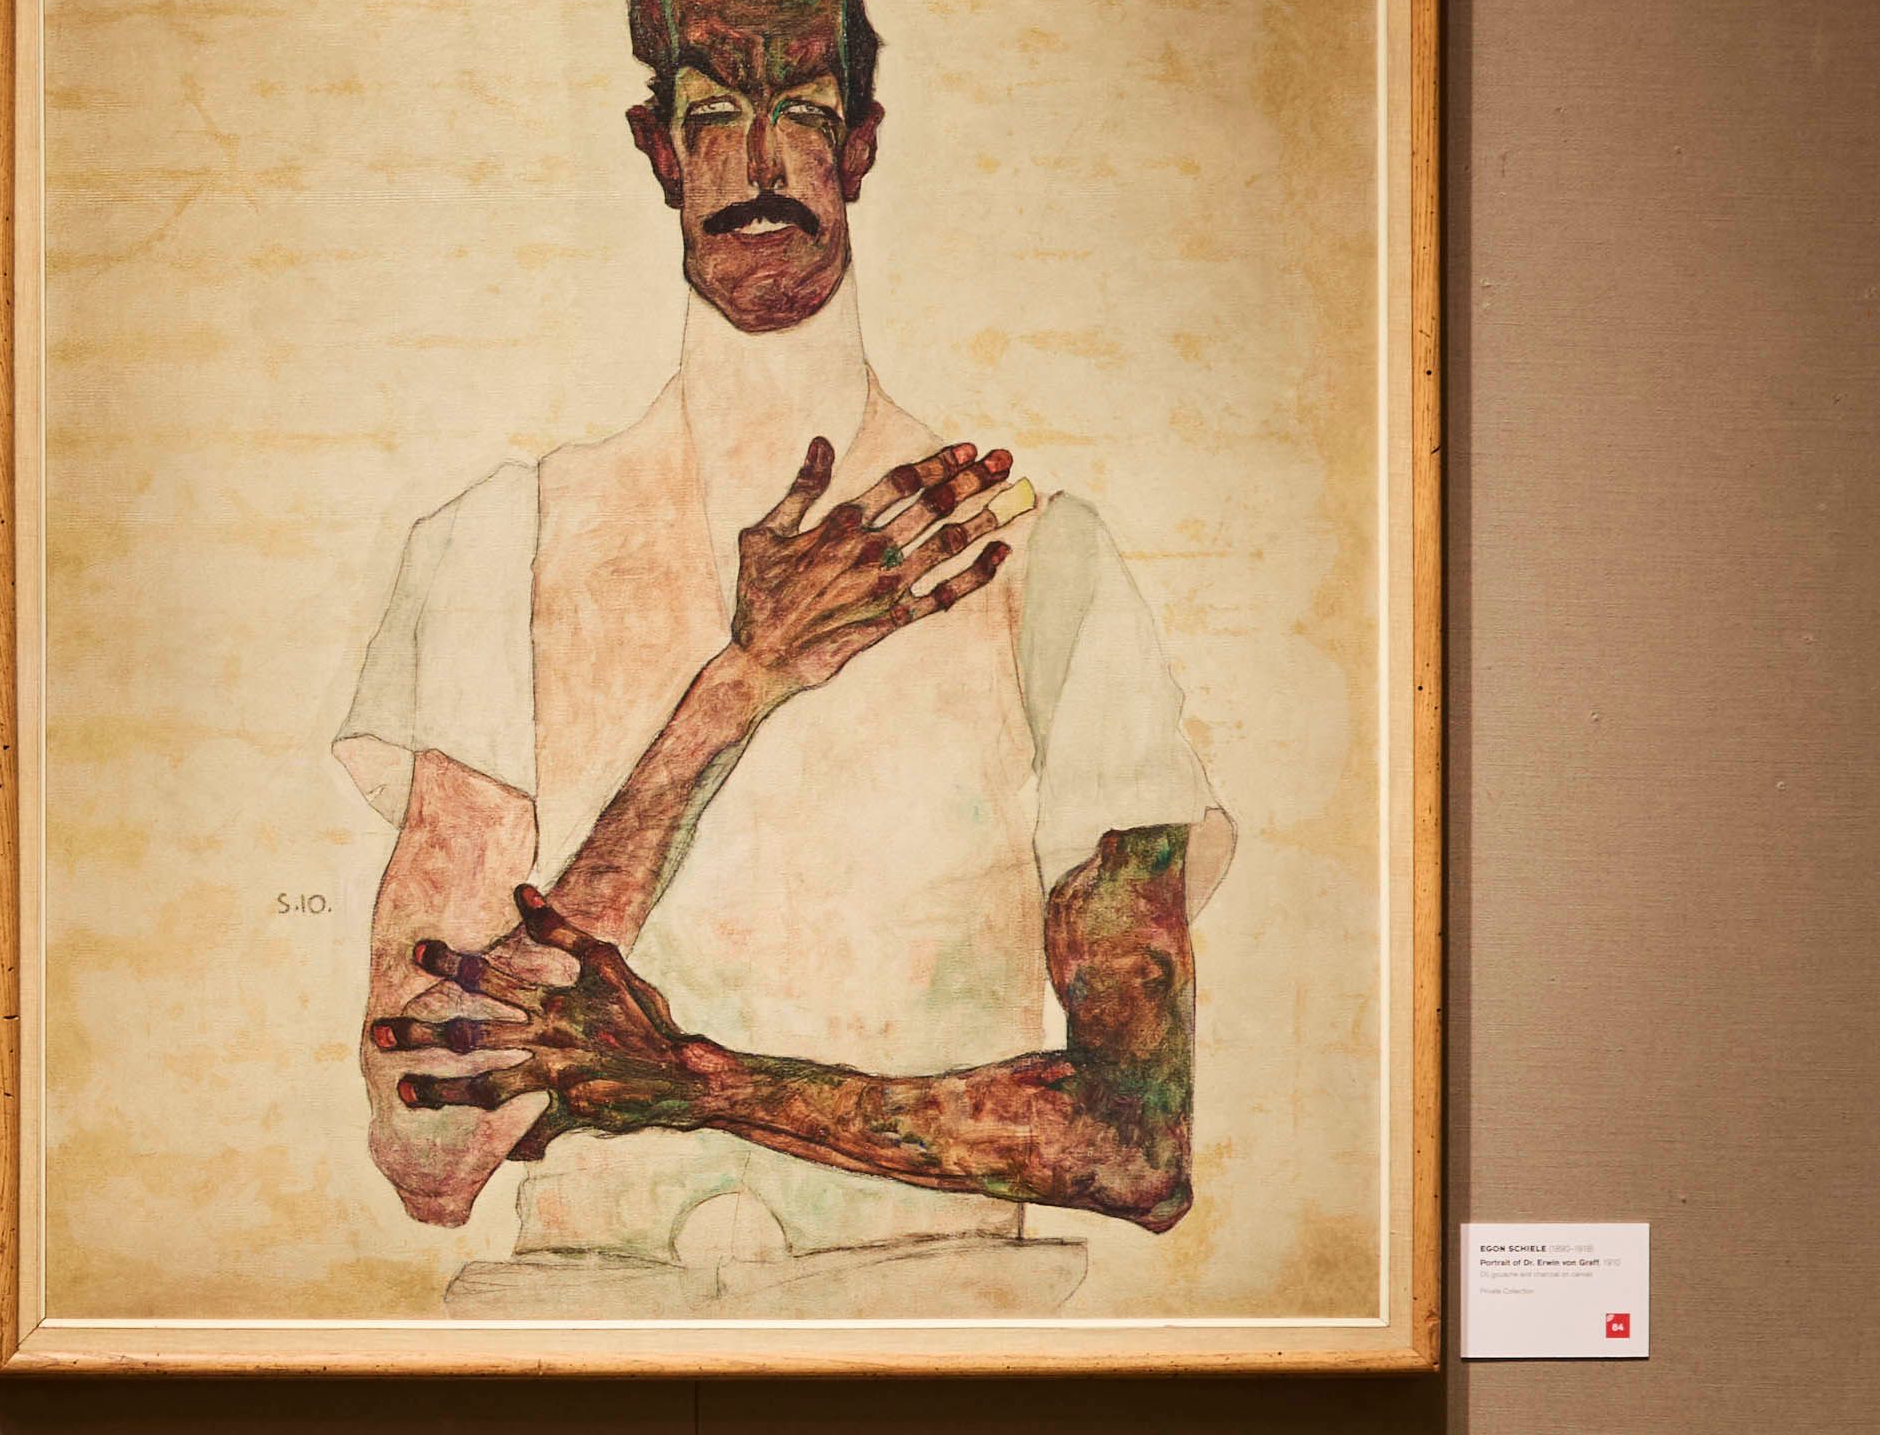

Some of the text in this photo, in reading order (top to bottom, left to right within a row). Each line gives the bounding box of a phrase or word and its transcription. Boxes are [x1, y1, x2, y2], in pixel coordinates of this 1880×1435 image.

[1480, 1245, 1506, 1253] EGON
[1508, 1245, 1547, 1253] SCHIELE
[1480, 1259, 1511, 1267] Portrait
[1513, 1259, 1522, 1267] of
[1523, 1259, 1535, 1267] Dr.
[1537, 1259, 1560, 1267] Erwin
